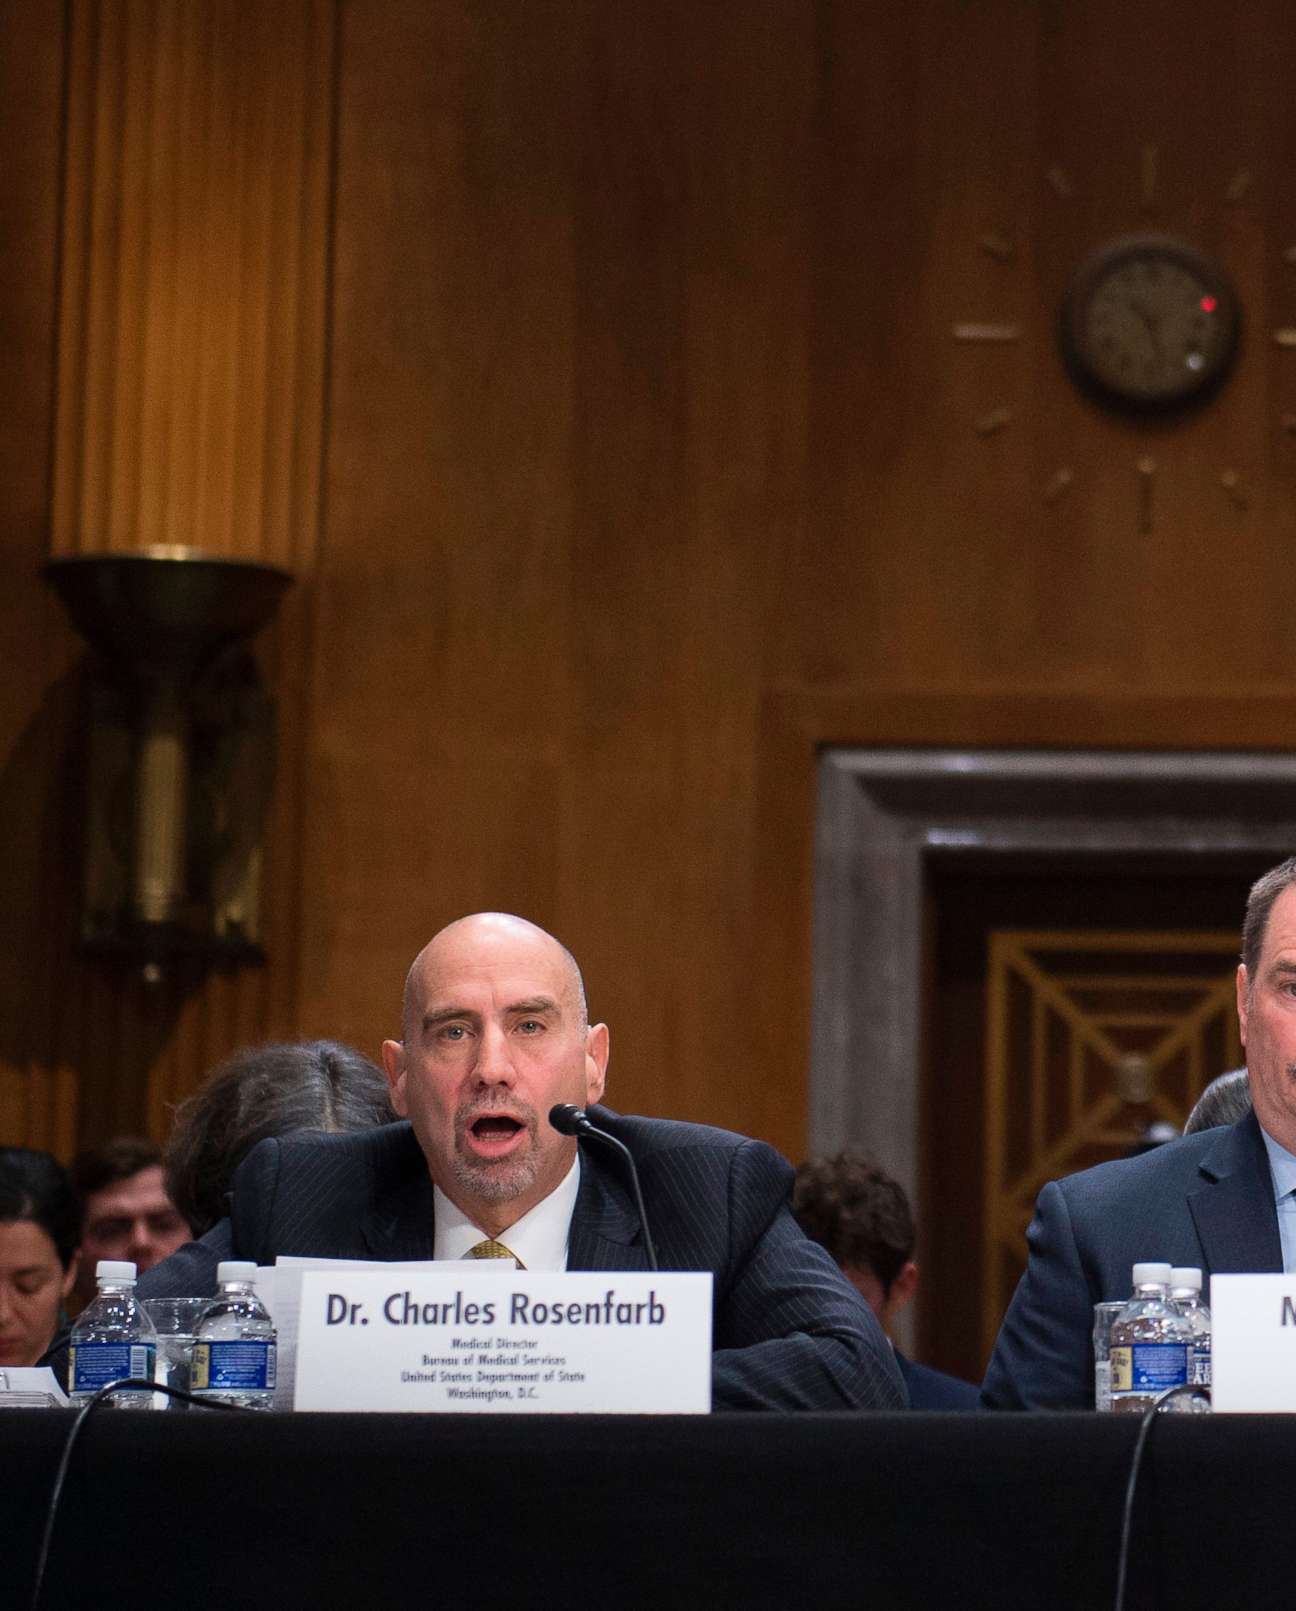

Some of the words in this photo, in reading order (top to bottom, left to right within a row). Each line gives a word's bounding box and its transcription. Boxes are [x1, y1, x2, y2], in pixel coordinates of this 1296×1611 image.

[326, 1293, 370, 1326] Dr.
[382, 1291, 496, 1326] Charles
[509, 1290, 666, 1326] Rosenfarb
[450, 1337, 493, 1350] Medical
[496, 1338, 538, 1349] Director
[421, 1354, 460, 1367] Bureau
[462, 1353, 474, 1366] of
[477, 1353, 519, 1366] Medical
[522, 1354, 566, 1366] Services
[400, 1370, 437, 1383] United
[439, 1371, 473, 1383] States
[476, 1370, 540, 1385] Department
[543, 1370, 555, 1382] of
[558, 1371, 585, 1382] State
[446, 1386, 514, 1403] Washington,
[517, 1387, 539, 1399] D.C.
